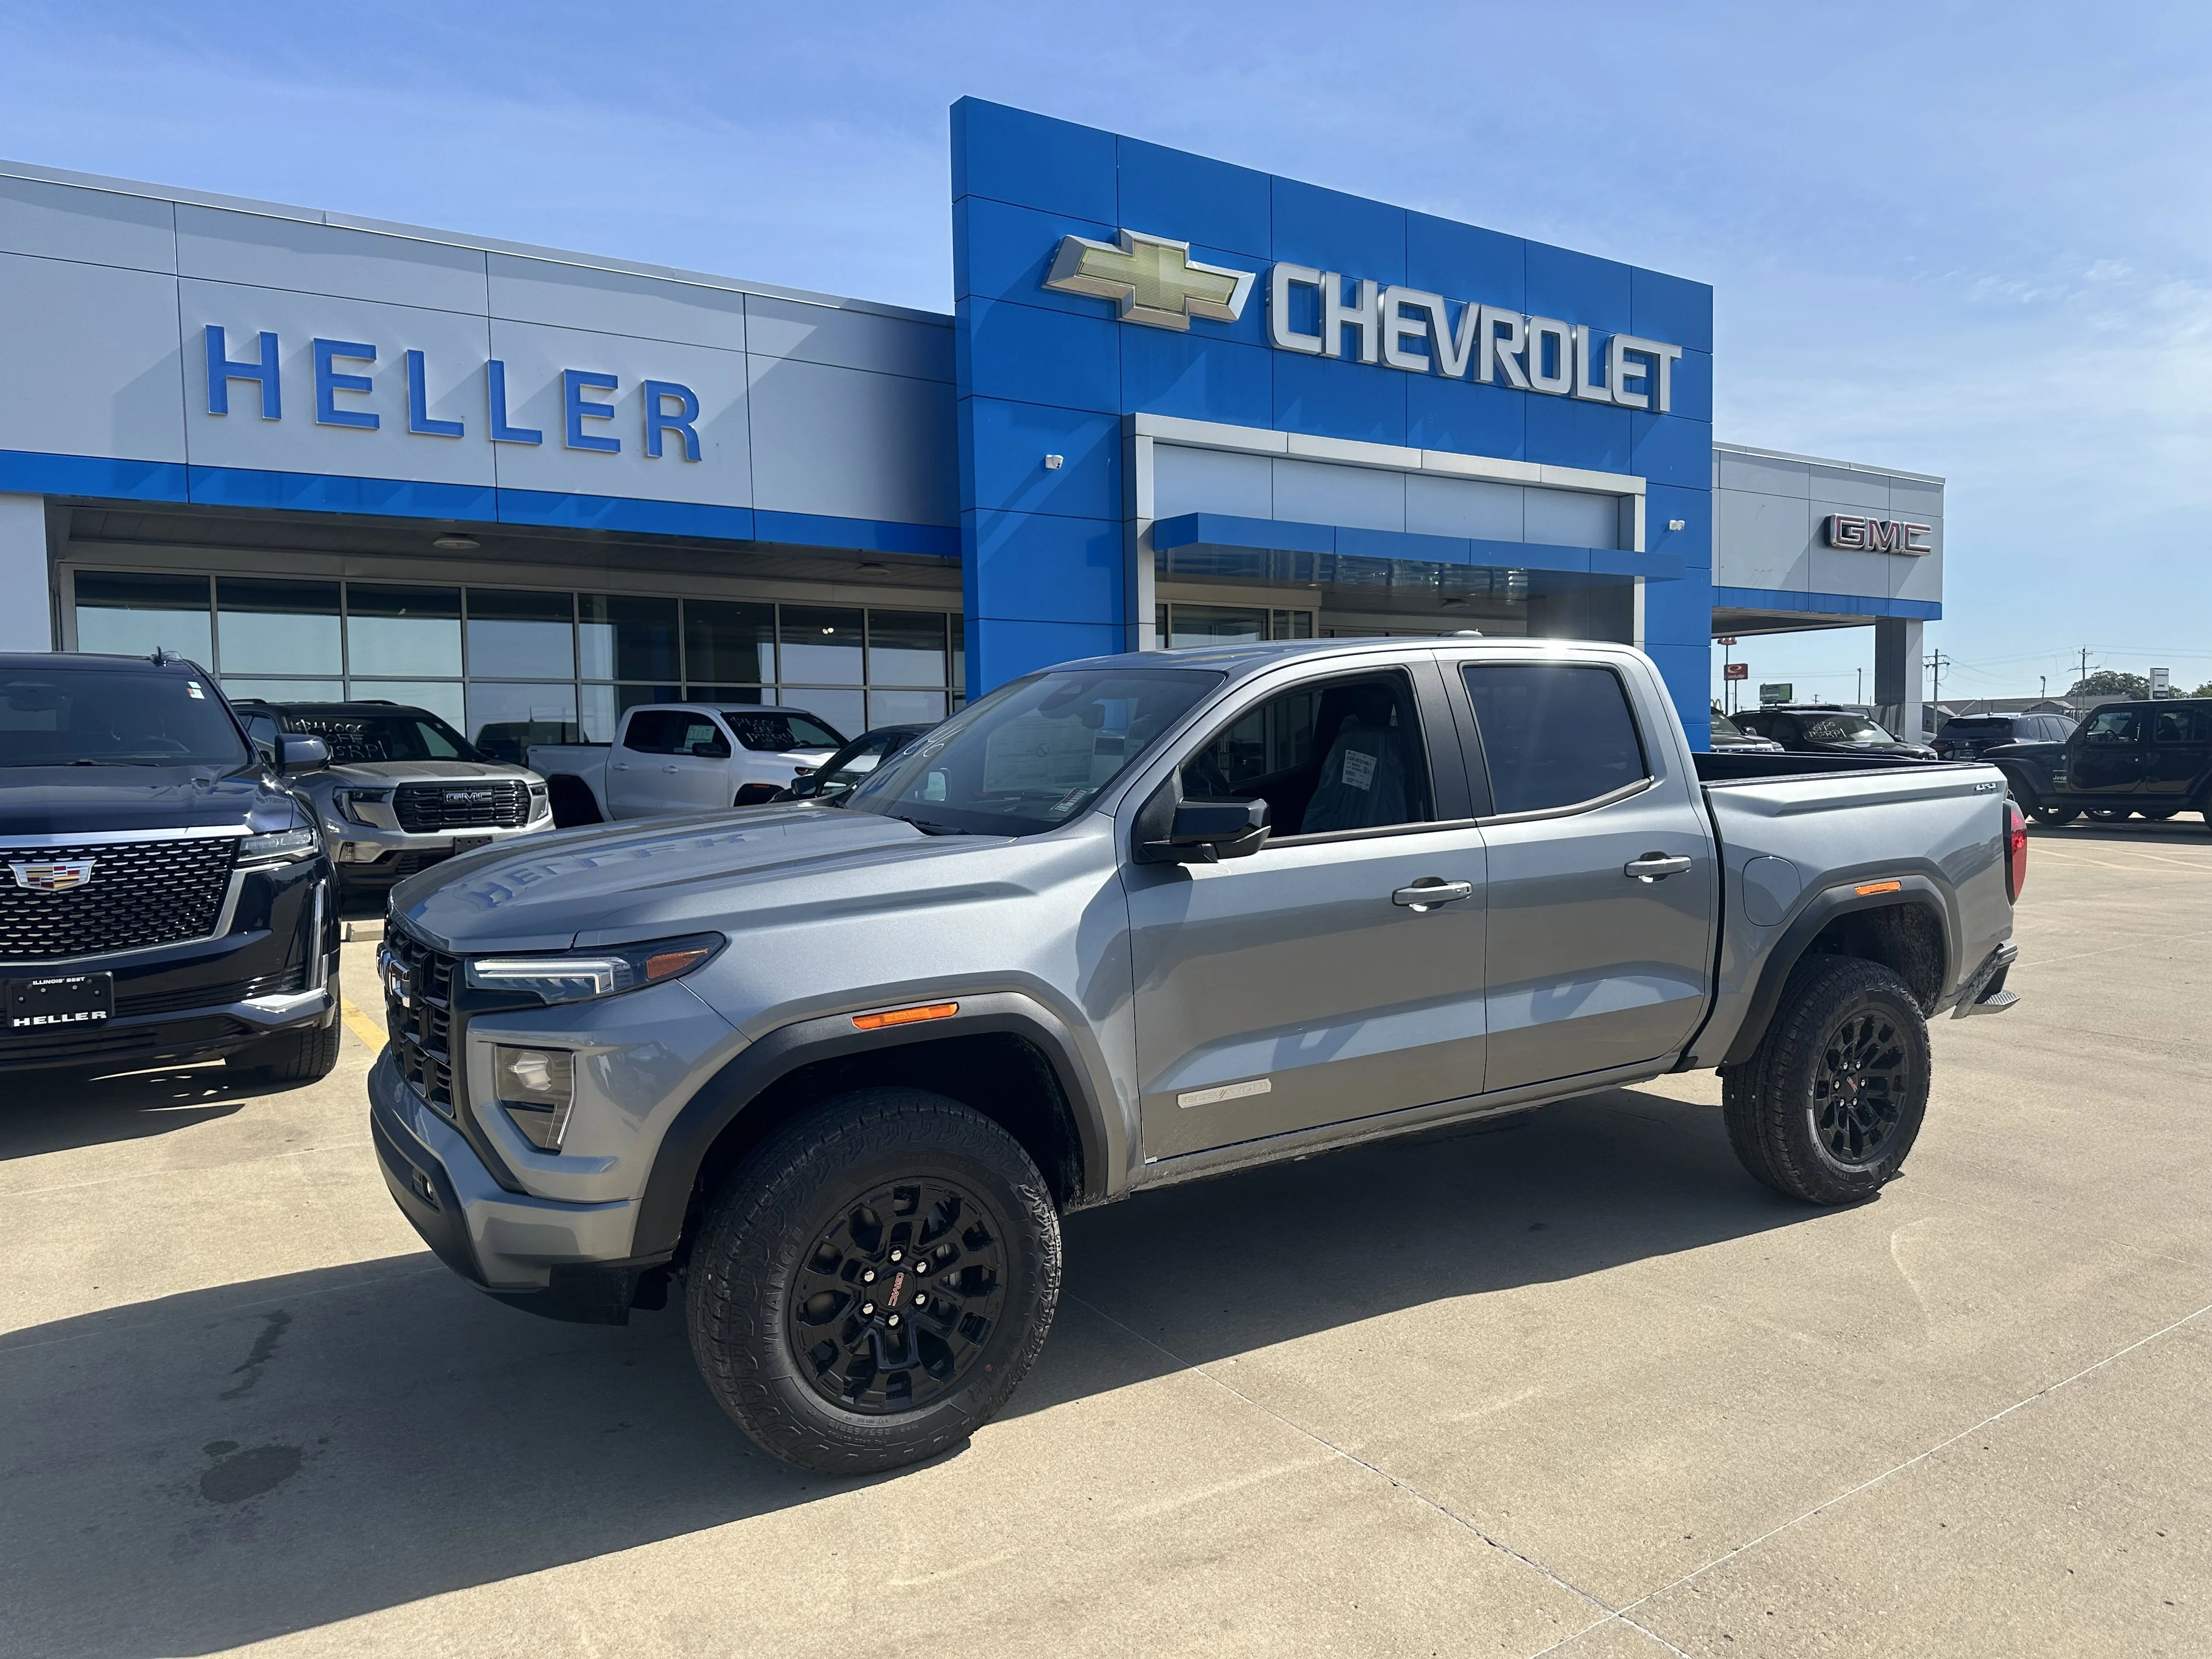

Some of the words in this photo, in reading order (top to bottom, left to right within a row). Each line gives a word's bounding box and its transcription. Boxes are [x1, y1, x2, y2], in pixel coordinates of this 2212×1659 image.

[1266, 261, 1683, 414] CHEVROLET
[205, 324, 702, 462] HELLER
[1828, 512, 1932, 556] GMC
[325, 733, 364, 744] OFF
[445, 791, 492, 803] GMC
[13, 1011, 107, 1027] HELLER
[1184, 1082, 1266, 1104] ELEVATION
[888, 1272, 904, 1306] GMC
